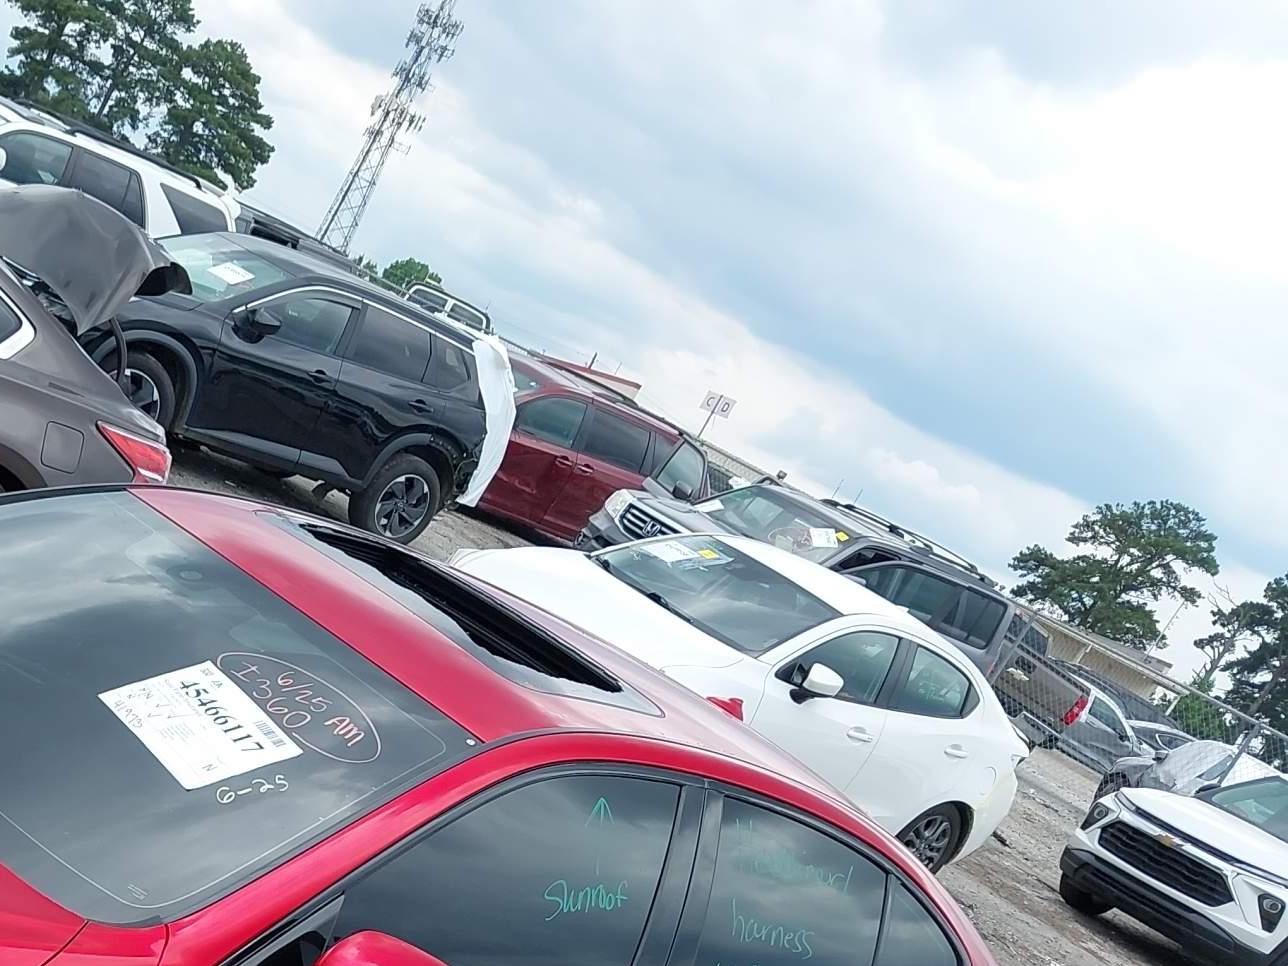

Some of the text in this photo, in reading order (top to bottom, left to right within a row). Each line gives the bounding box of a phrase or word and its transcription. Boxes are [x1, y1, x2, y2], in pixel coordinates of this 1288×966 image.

[721, 401, 730, 413] D
[276, 671, 334, 712] 6/25
[179, 680, 265, 753] 45466117
[216, 774, 289, 804] 6-25
[730, 898, 816, 959] harness
